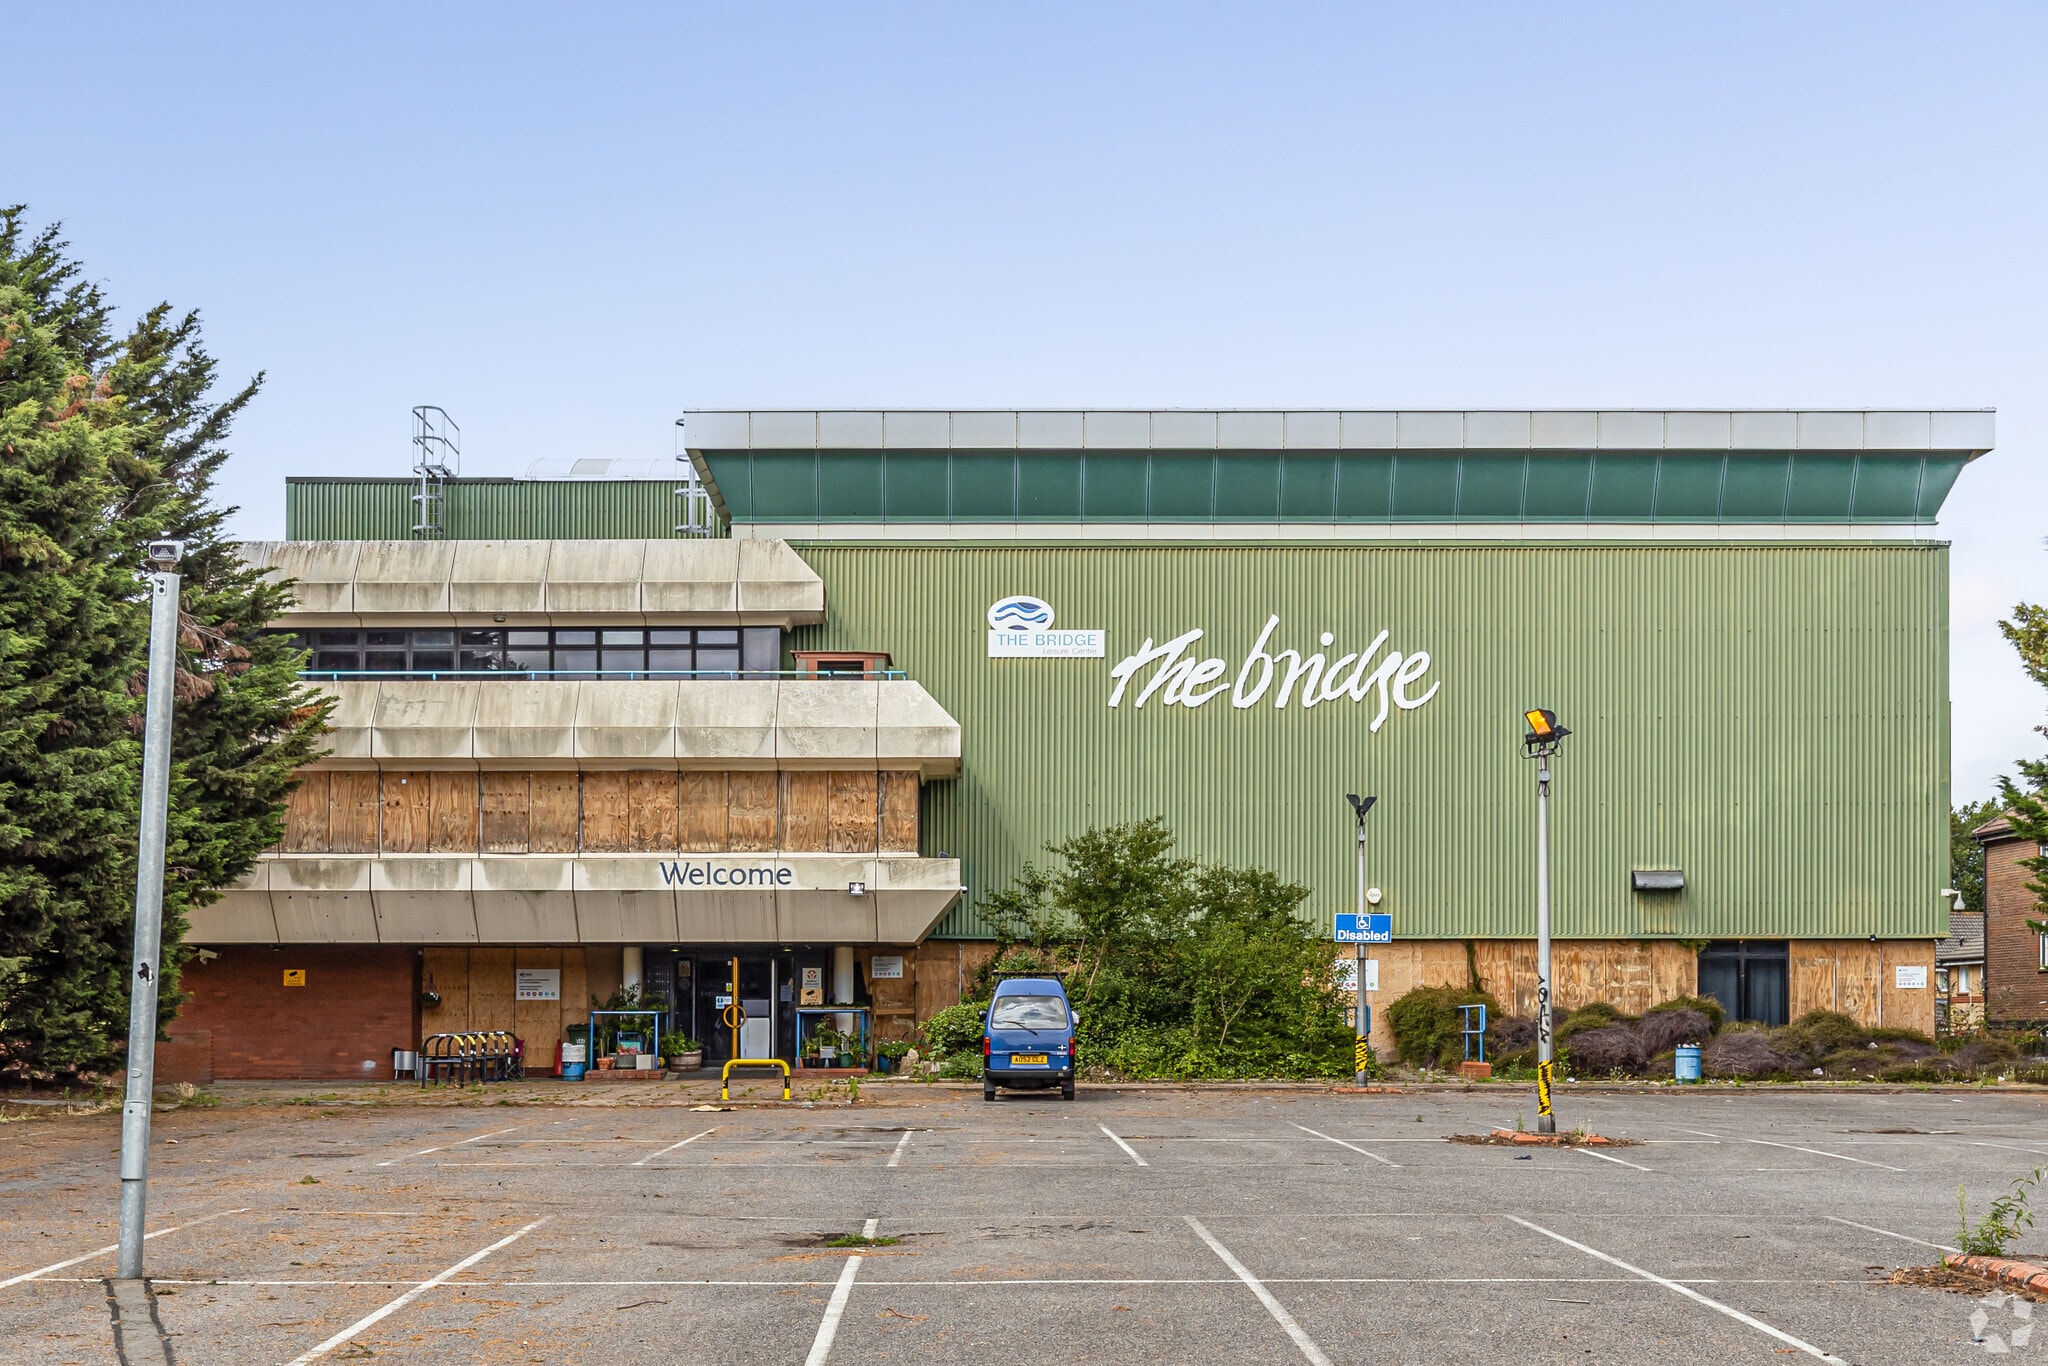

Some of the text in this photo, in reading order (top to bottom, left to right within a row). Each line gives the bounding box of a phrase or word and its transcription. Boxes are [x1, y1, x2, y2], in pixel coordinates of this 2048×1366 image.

[997, 634, 1097, 646] THE BRIDGE
[1232, 614, 1441, 734] bridge
[659, 862, 792, 885] Welcome
[1337, 930, 1389, 941] Disabled
